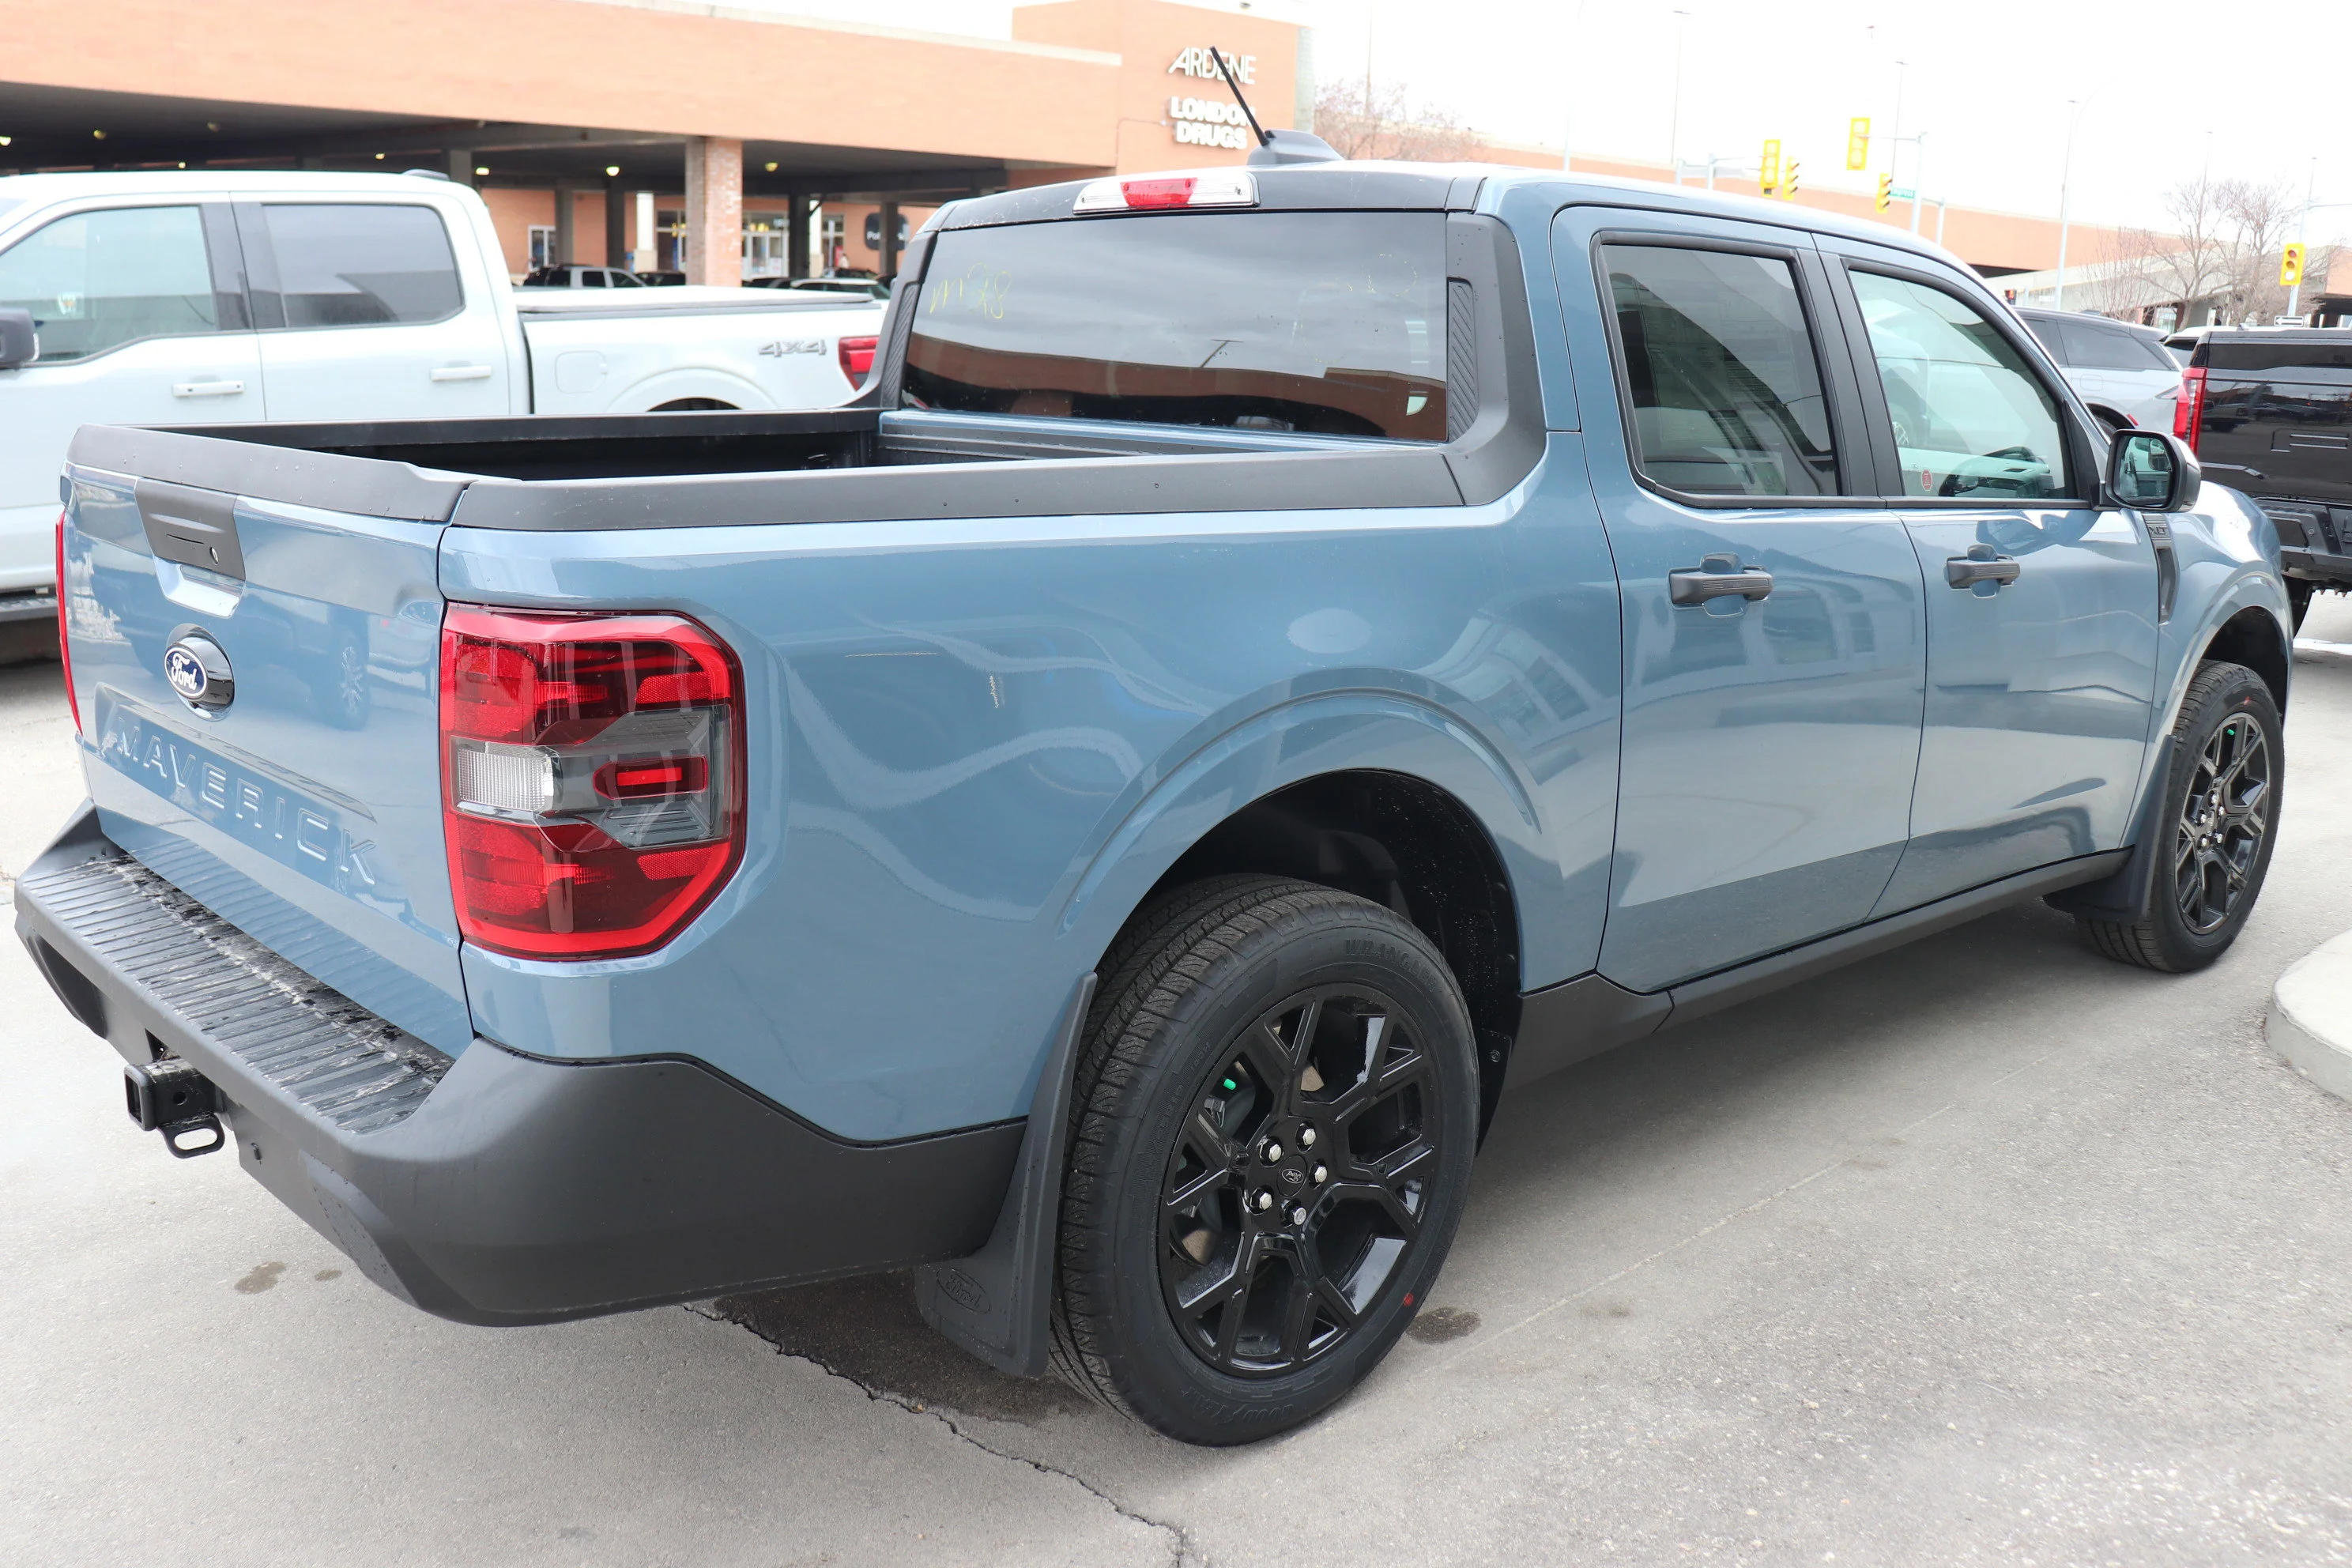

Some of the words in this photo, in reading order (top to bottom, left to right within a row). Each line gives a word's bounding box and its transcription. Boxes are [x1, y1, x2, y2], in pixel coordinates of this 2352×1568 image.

[1168, 47, 1257, 85] ARDENE
[1170, 96, 1256, 127] LONDON
[1176, 120, 1247, 149] DRUGS
[170, 652, 198, 691] Ford
[118, 716, 377, 885] MAVERICK
[945, 1273, 982, 1309] Ford
